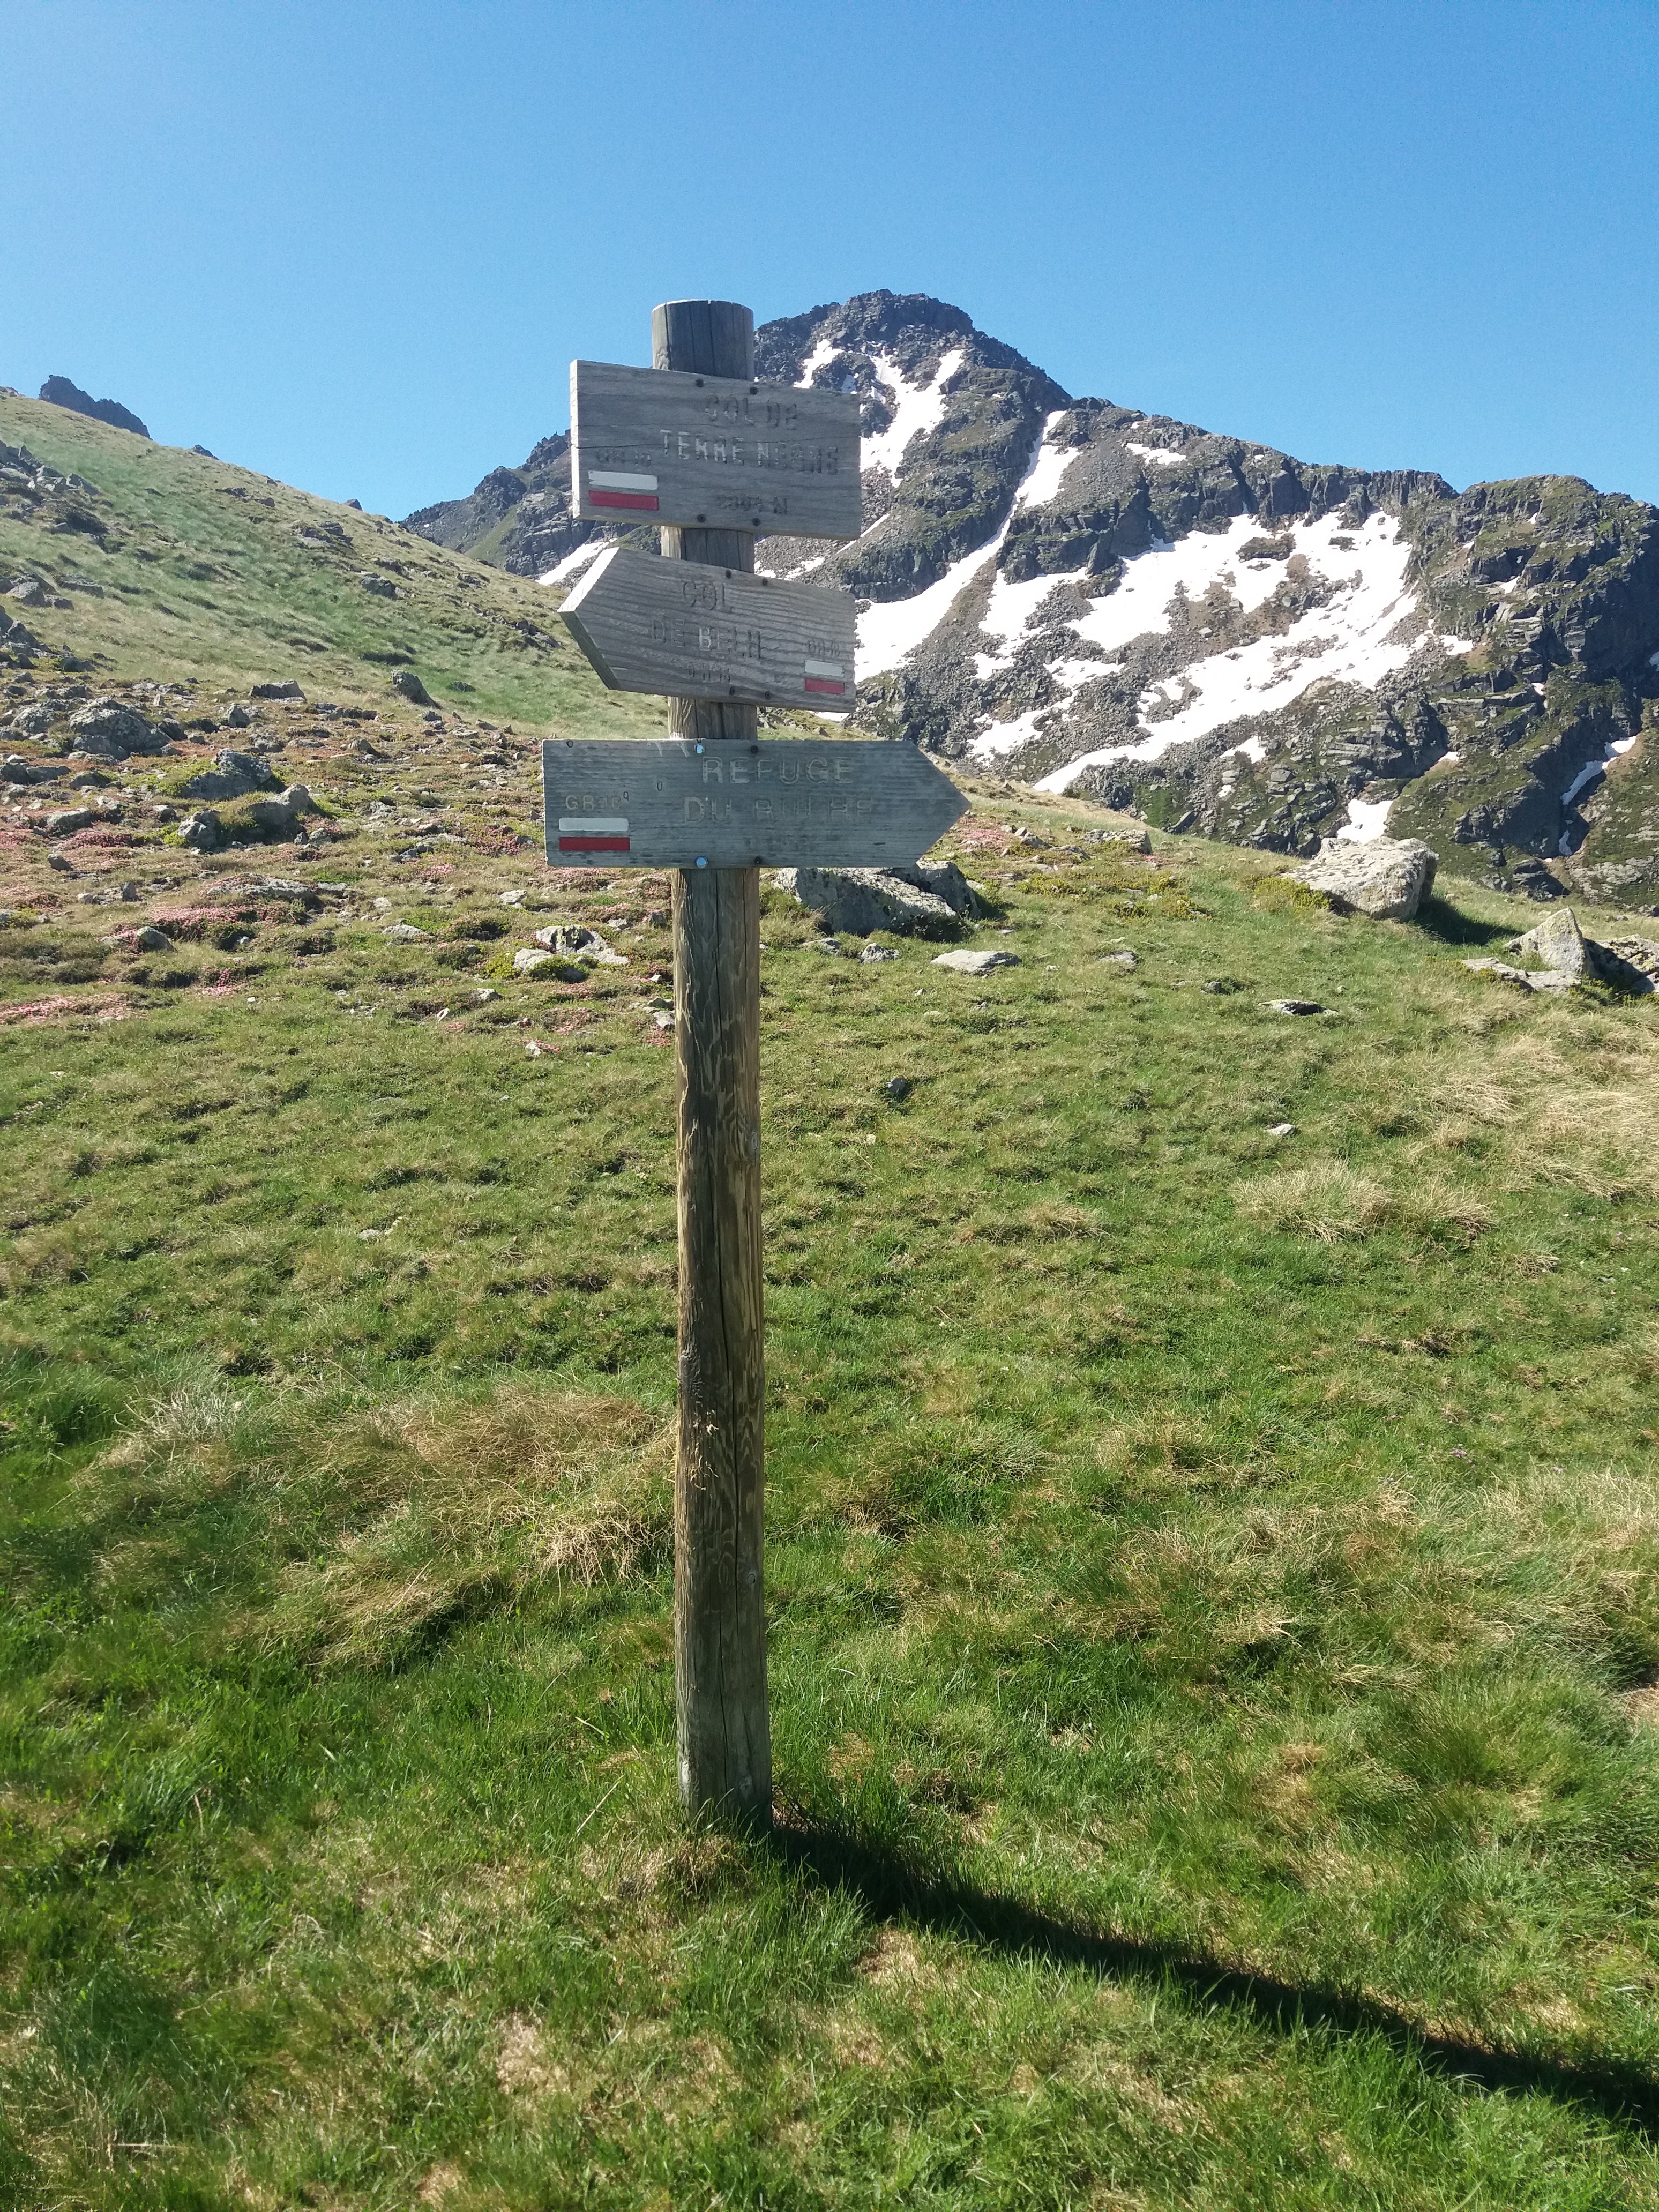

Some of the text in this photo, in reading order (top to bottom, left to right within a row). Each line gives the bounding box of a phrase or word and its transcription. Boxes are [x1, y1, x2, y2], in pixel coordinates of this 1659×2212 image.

[682, 581, 733, 614] COL
[702, 756, 854, 784] REFUGE
[565, 795, 595, 810] GR
[683, 796, 732, 824] DU
